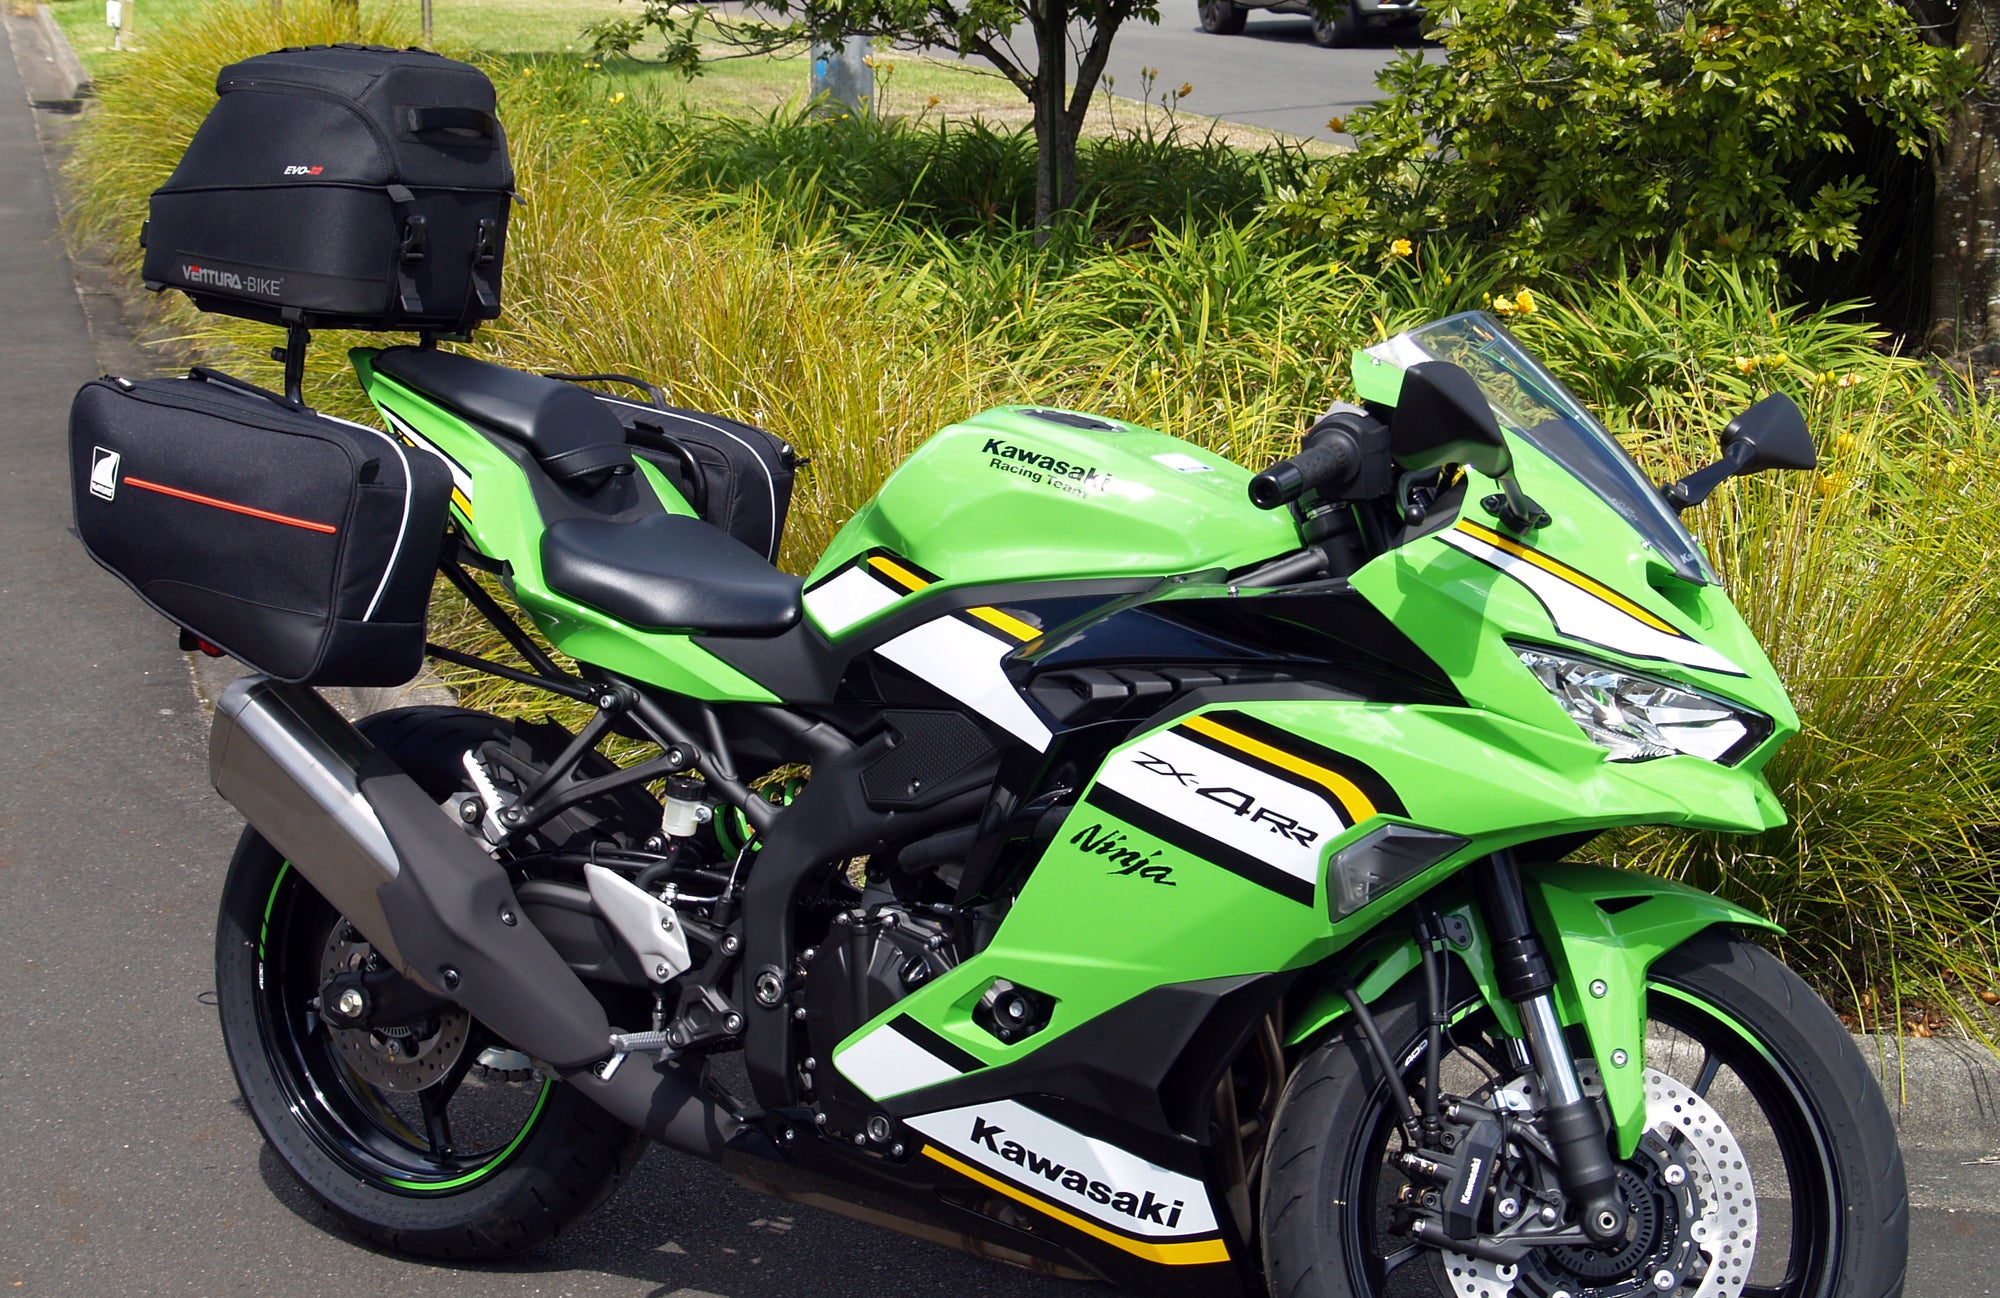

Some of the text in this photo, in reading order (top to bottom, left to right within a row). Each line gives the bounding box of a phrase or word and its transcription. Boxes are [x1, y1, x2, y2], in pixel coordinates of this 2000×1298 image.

[981, 438, 1113, 492] Kawasaki
[989, 457, 1043, 483] Racing
[1131, 750, 1319, 849] ZX-4RR
[1070, 823, 1177, 886] Ninja
[1404, 1038, 1429, 1067] 400
[970, 1115, 1185, 1229] Kawasaki
